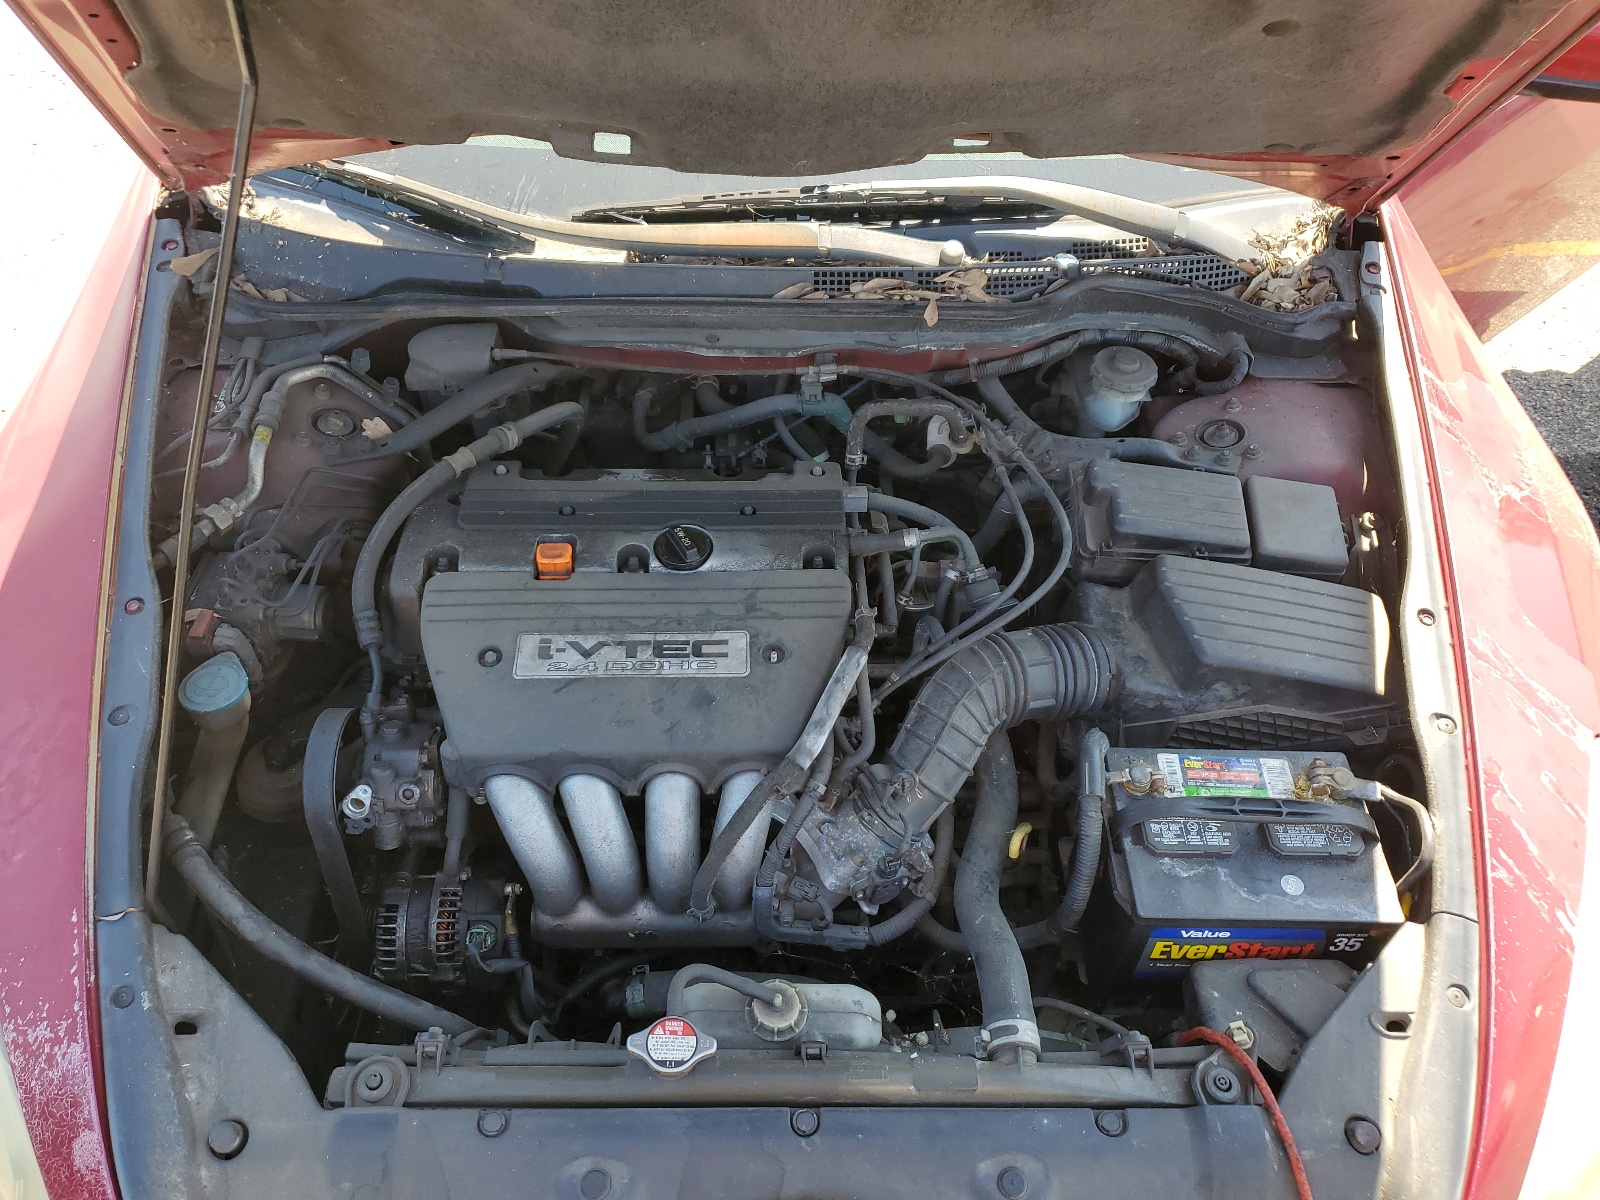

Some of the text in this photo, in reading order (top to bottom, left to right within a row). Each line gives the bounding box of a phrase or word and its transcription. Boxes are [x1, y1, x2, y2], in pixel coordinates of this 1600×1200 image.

[674, 527, 692, 546] 5W-20
[537, 637, 729, 660] i-VTEC
[547, 659, 718, 672] 2.4 DOHC
[1183, 758, 1227, 769] EverStart
[1180, 929, 1231, 938] Value
[1149, 941, 1316, 960] EverStart
[1328, 937, 1365, 952] 35
